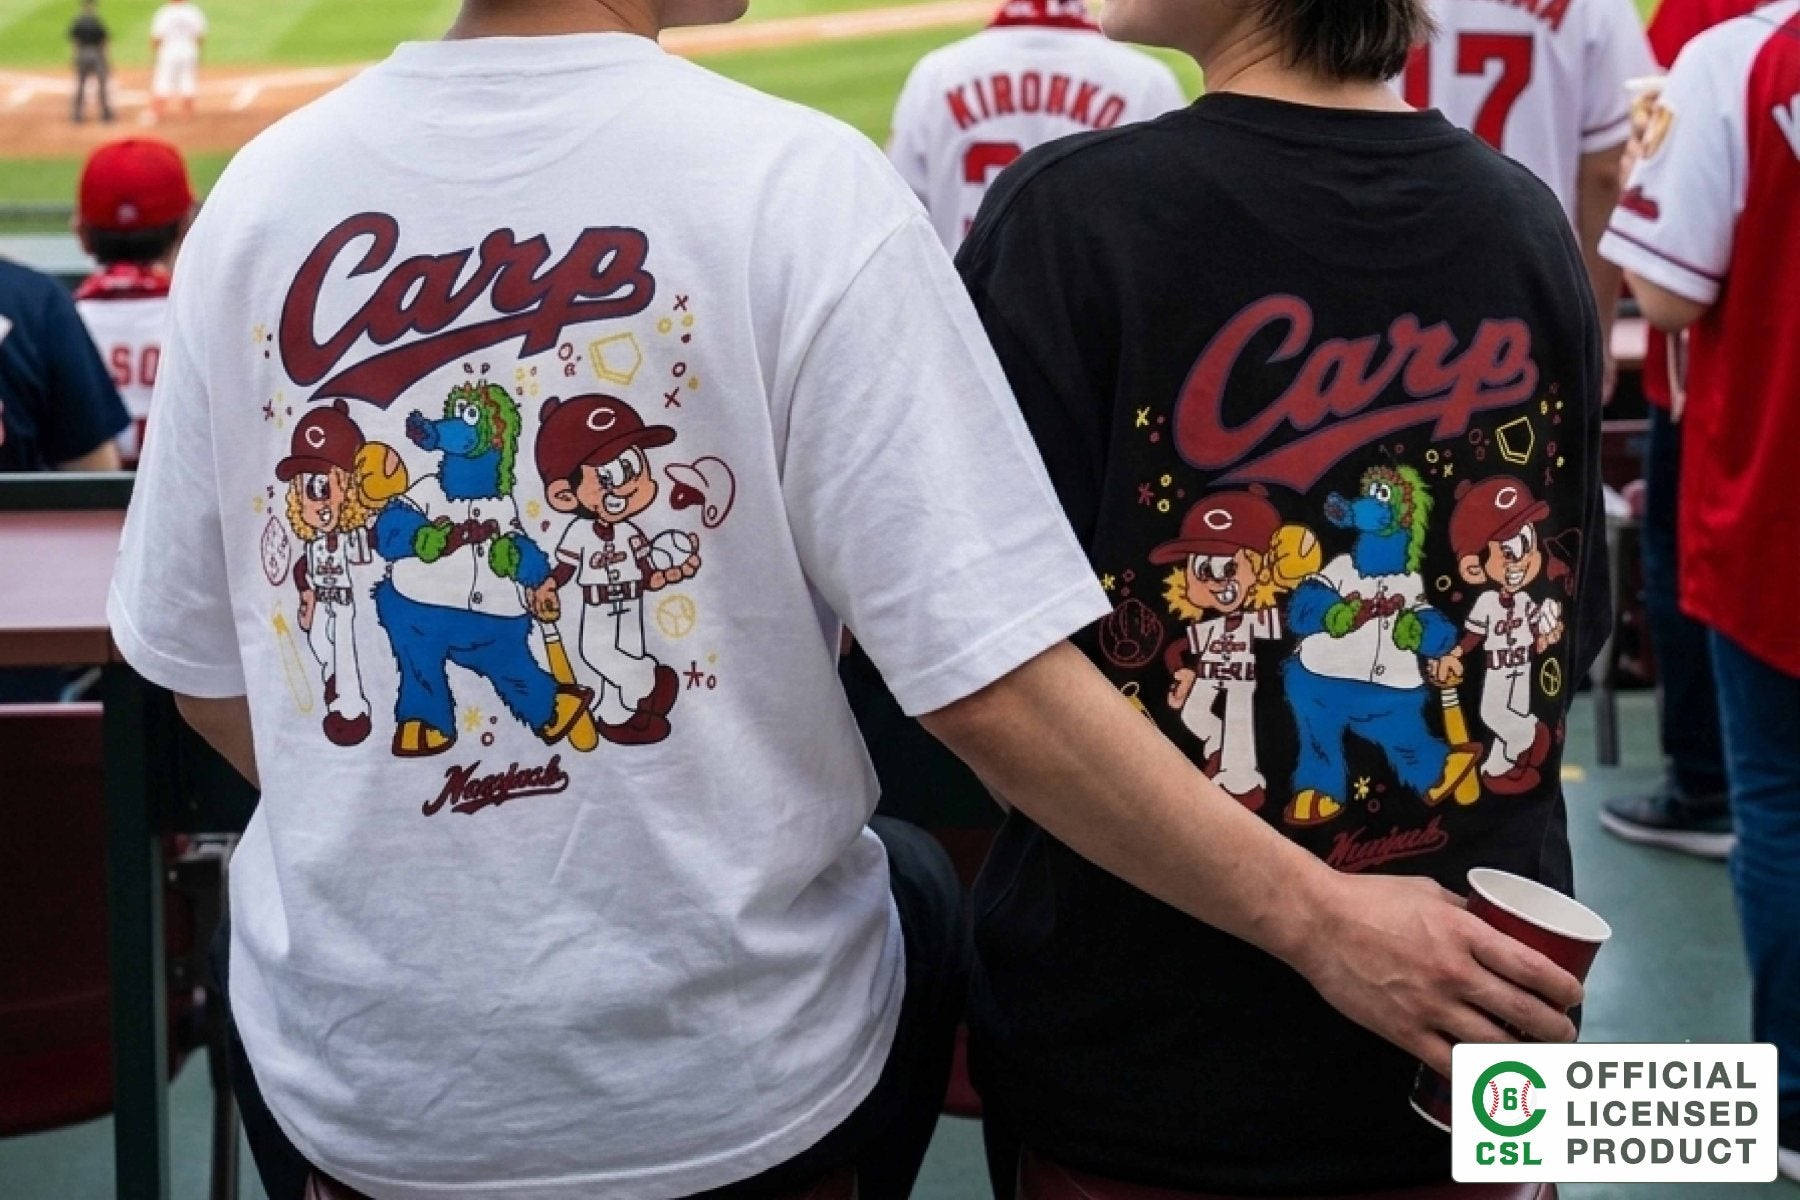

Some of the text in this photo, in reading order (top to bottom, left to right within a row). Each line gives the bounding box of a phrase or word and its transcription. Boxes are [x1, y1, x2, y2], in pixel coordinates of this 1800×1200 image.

[279, 211, 656, 390] Carp
[586, 406, 616, 432] C
[1173, 293, 1540, 470] Carp
[1203, 508, 1233, 530] C
